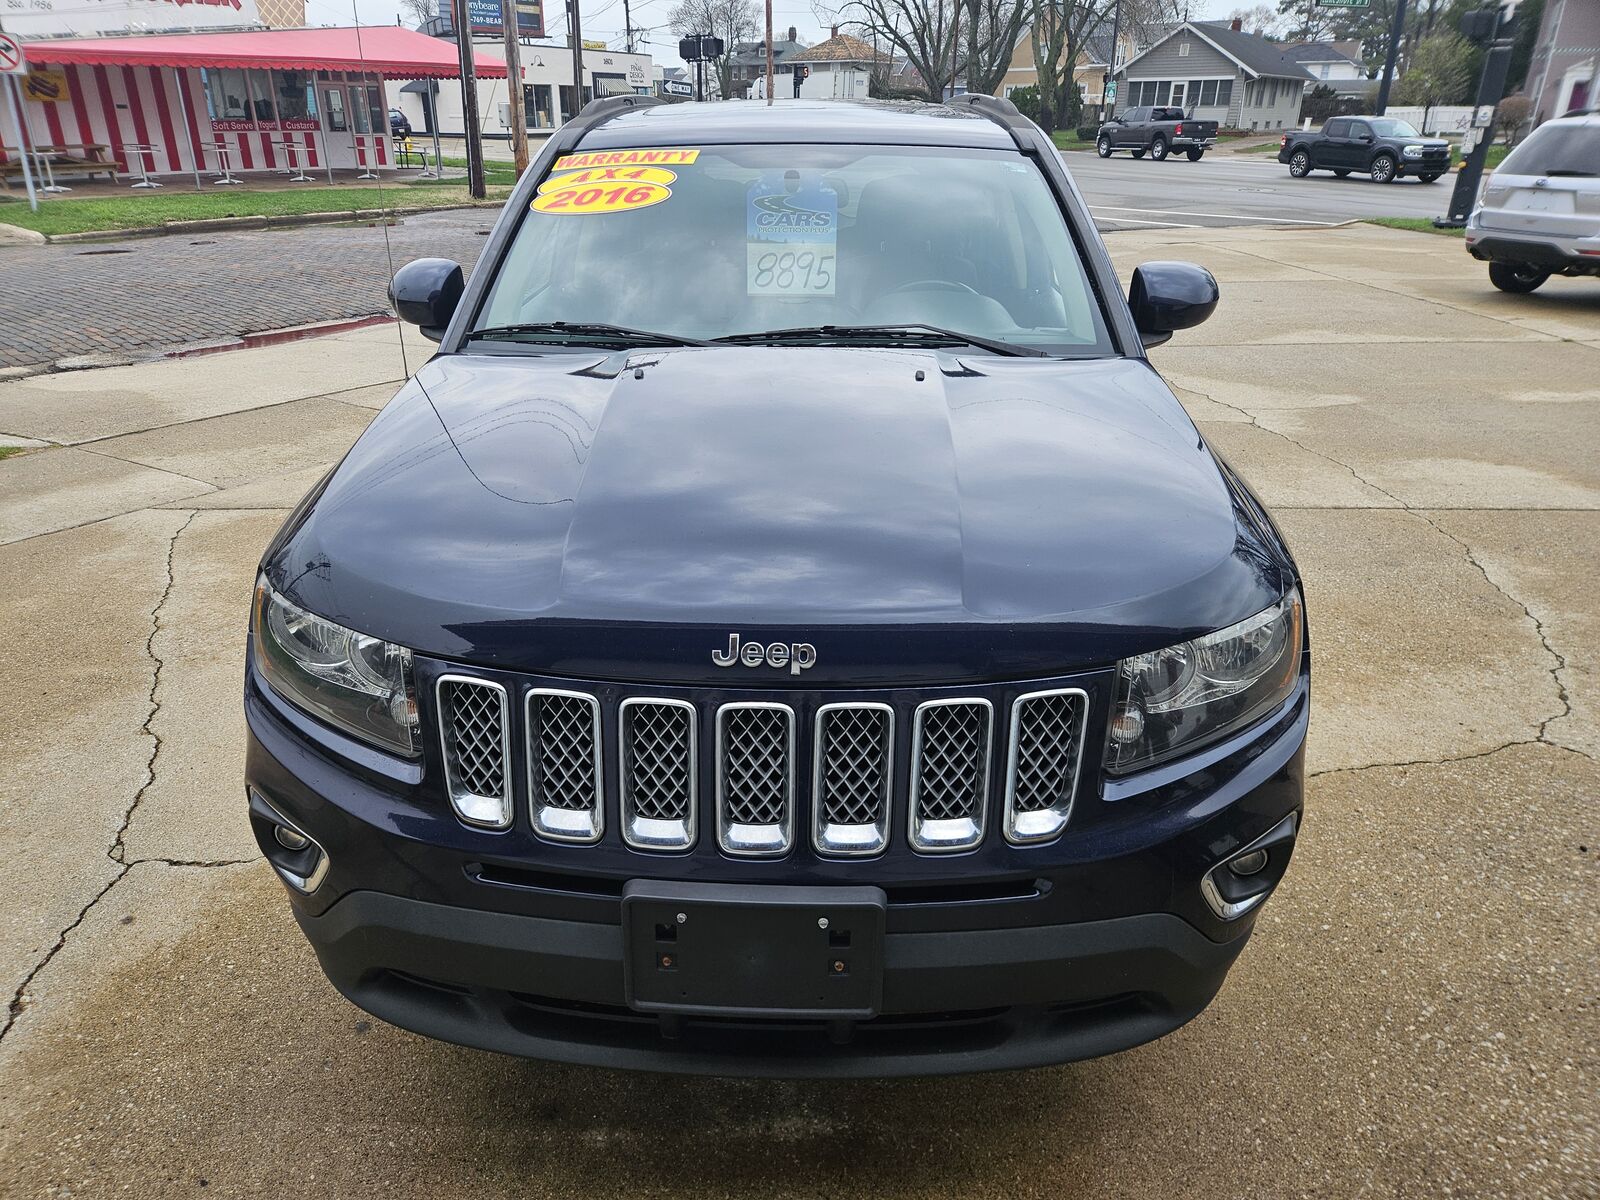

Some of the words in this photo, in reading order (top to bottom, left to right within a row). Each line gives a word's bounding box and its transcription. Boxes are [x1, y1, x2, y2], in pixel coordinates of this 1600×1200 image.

[30, 0, 53, 10] 1956
[212, 121, 229, 130] Soft
[231, 122, 254, 130] Serve
[258, 120, 277, 130] Yogurt
[285, 121, 315, 130] Custard
[556, 151, 695, 169] WARRANTY
[544, 186, 656, 210] 2016
[756, 212, 831, 226] CARS
[755, 251, 834, 290] 8895
[711, 633, 817, 676] Jeep
